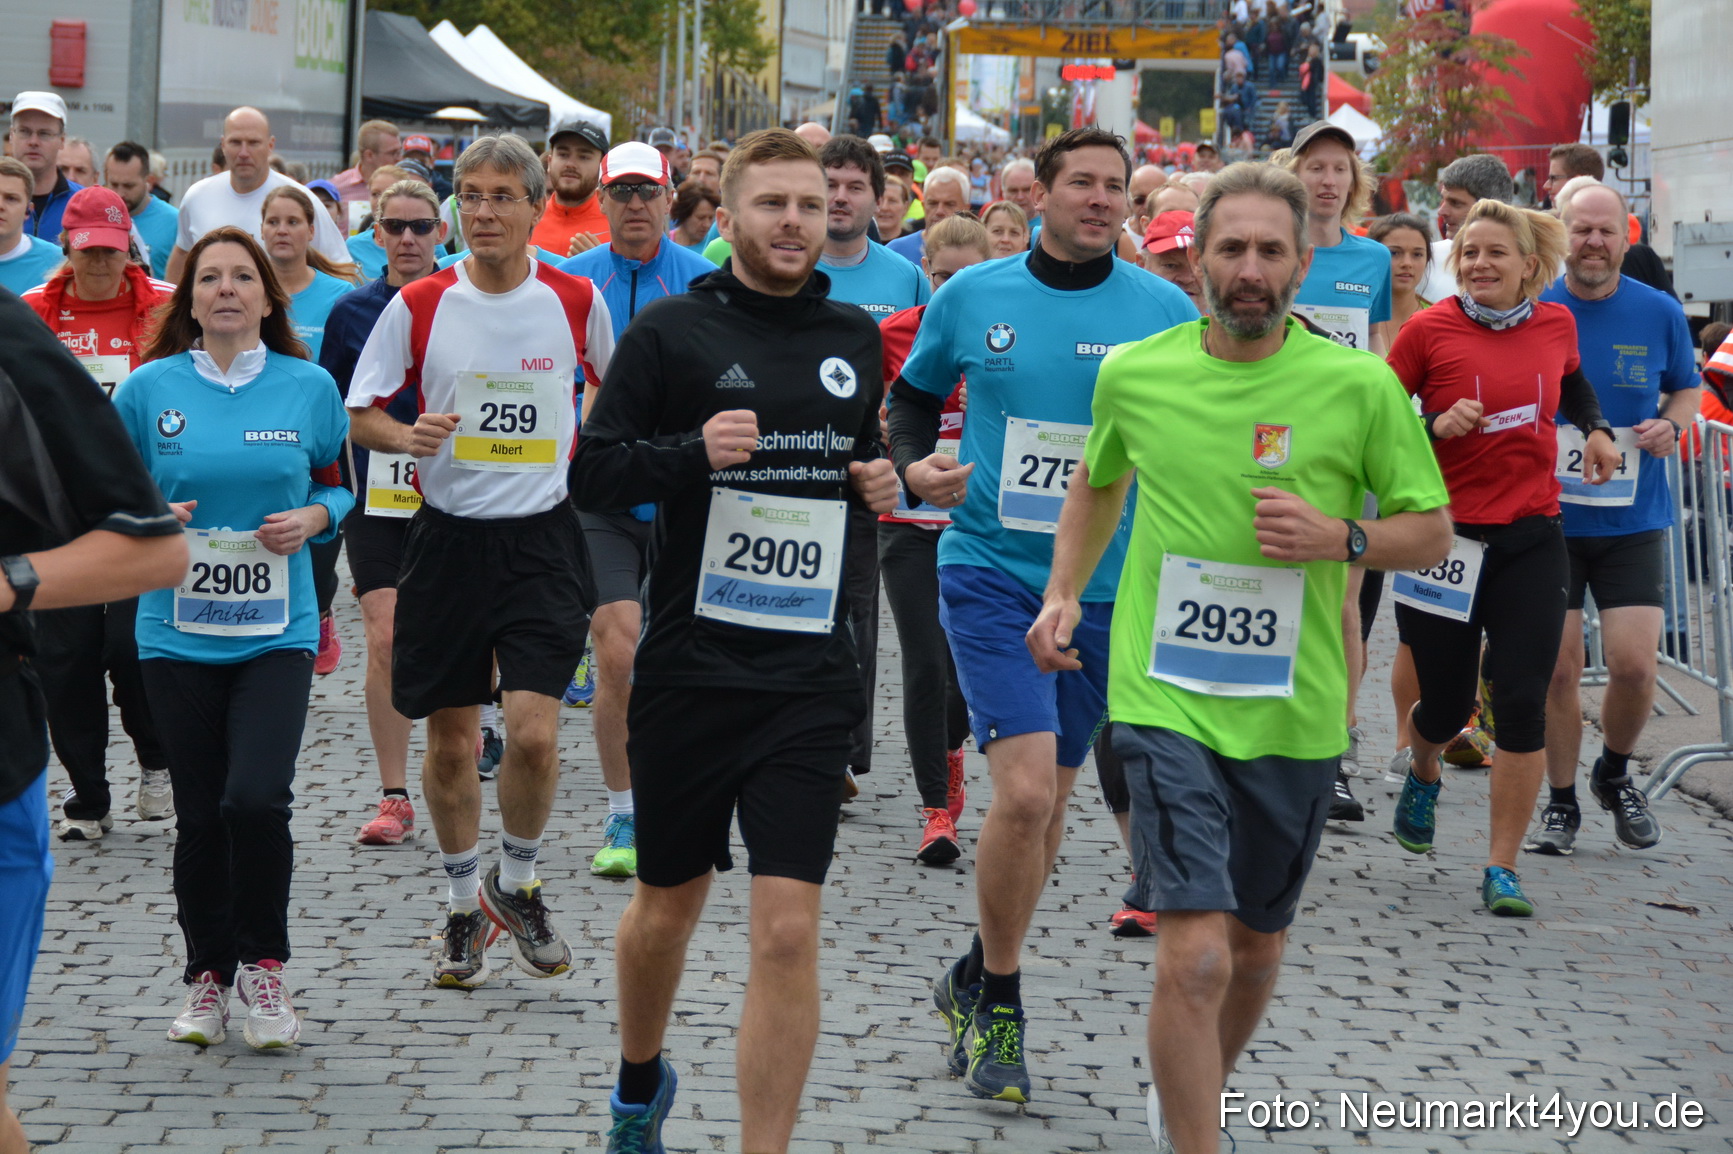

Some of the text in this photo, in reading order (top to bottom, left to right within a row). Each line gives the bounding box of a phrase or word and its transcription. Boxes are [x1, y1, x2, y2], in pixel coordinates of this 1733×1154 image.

[1061, 33, 1118, 54] ZIEL
[1335, 282, 1371, 294] BOCK
[1075, 342, 1116, 355] BO
[522, 358, 553, 370] MID
[497, 381, 534, 391] BOCK
[715, 379, 755, 388] adidas
[479, 402, 537, 433] 259
[1498, 412, 1522, 425] DEHN
[244, 430, 301, 443] BOCK
[490, 444, 522, 455] Albert
[1567, 450, 1626, 474] 24
[390, 460, 417, 485] 18
[1018, 454, 1080, 490] 275
[765, 508, 810, 522] BOCK
[220, 540, 257, 550] BOCK
[724, 532, 822, 580] 2909
[192, 562, 271, 595] 2908
[1213, 575, 1262, 590] BOCK
[707, 579, 815, 608] Alexander
[1413, 584, 1442, 599] Nadine
[193, 598, 264, 624] Anita
[1174, 599, 1278, 647] 2933
